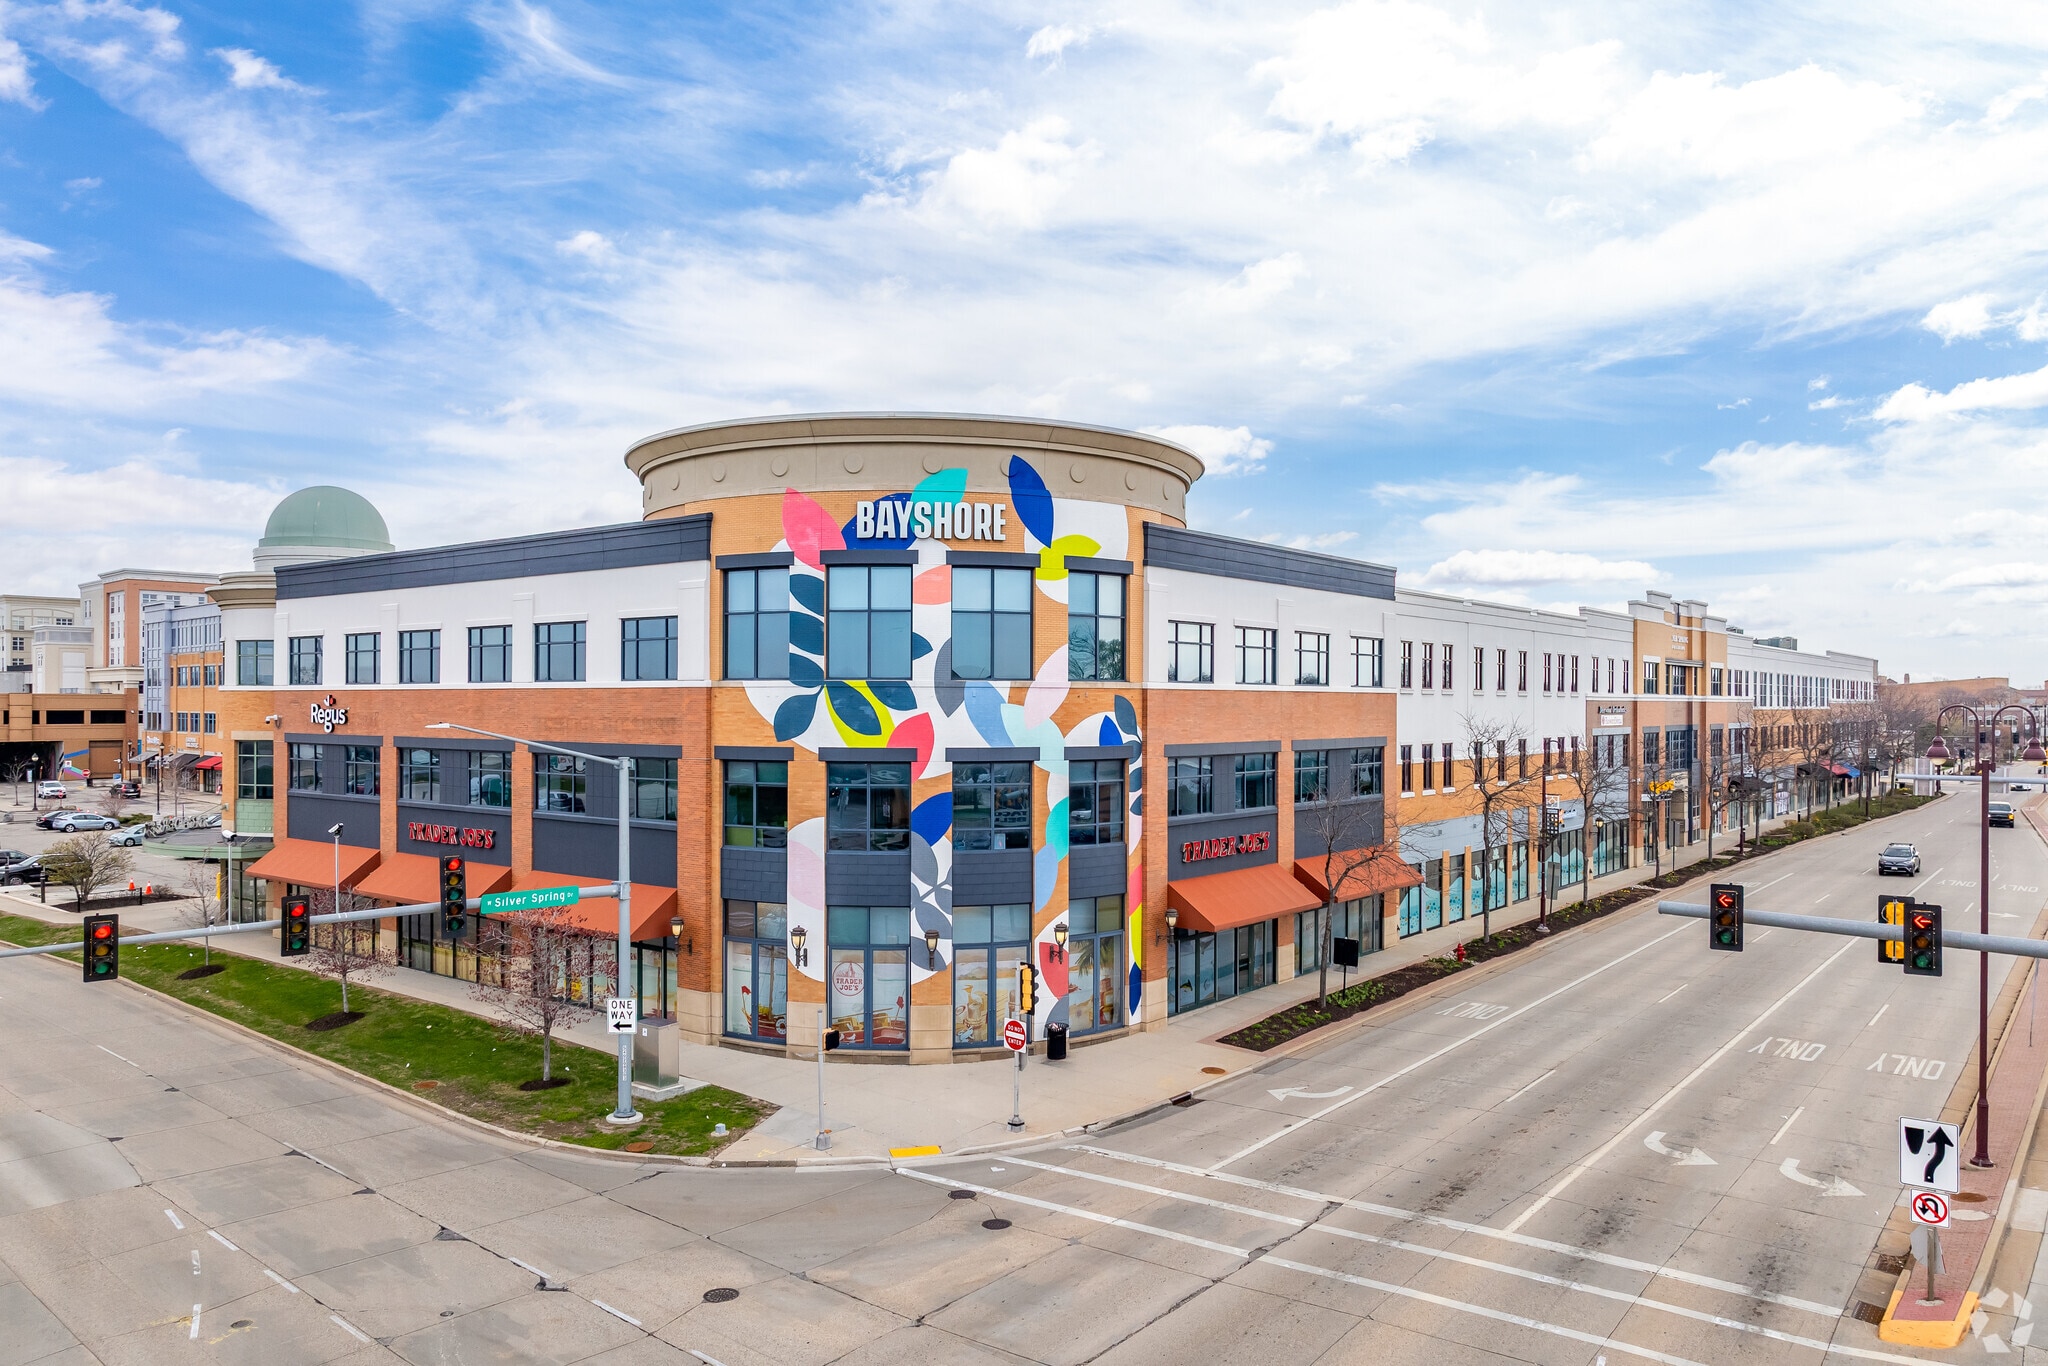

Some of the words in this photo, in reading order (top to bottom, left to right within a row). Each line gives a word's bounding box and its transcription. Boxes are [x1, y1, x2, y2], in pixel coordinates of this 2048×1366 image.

[856, 500, 1007, 541] BAYSHORE
[310, 703, 347, 733] Regus
[408, 822, 457, 845] TRADER
[459, 828, 494, 849] JOE'S
[1182, 835, 1237, 863] TRADER
[1238, 831, 1270, 854] JOE'S
[1937, 879, 1977, 888] ONLY
[1998, 884, 2039, 893] ONLY
[494, 897, 526, 907] Silver
[531, 892, 565, 902] Spring
[611, 1011, 632, 1019] WAY
[612, 1001, 632, 1010] ONE
[1434, 1001, 1509, 1020] ONLY
[1008, 1038, 1022, 1046] ENTER
[1747, 1036, 1827, 1062] ONLY
[1866, 1052, 1946, 1081] ONLY
